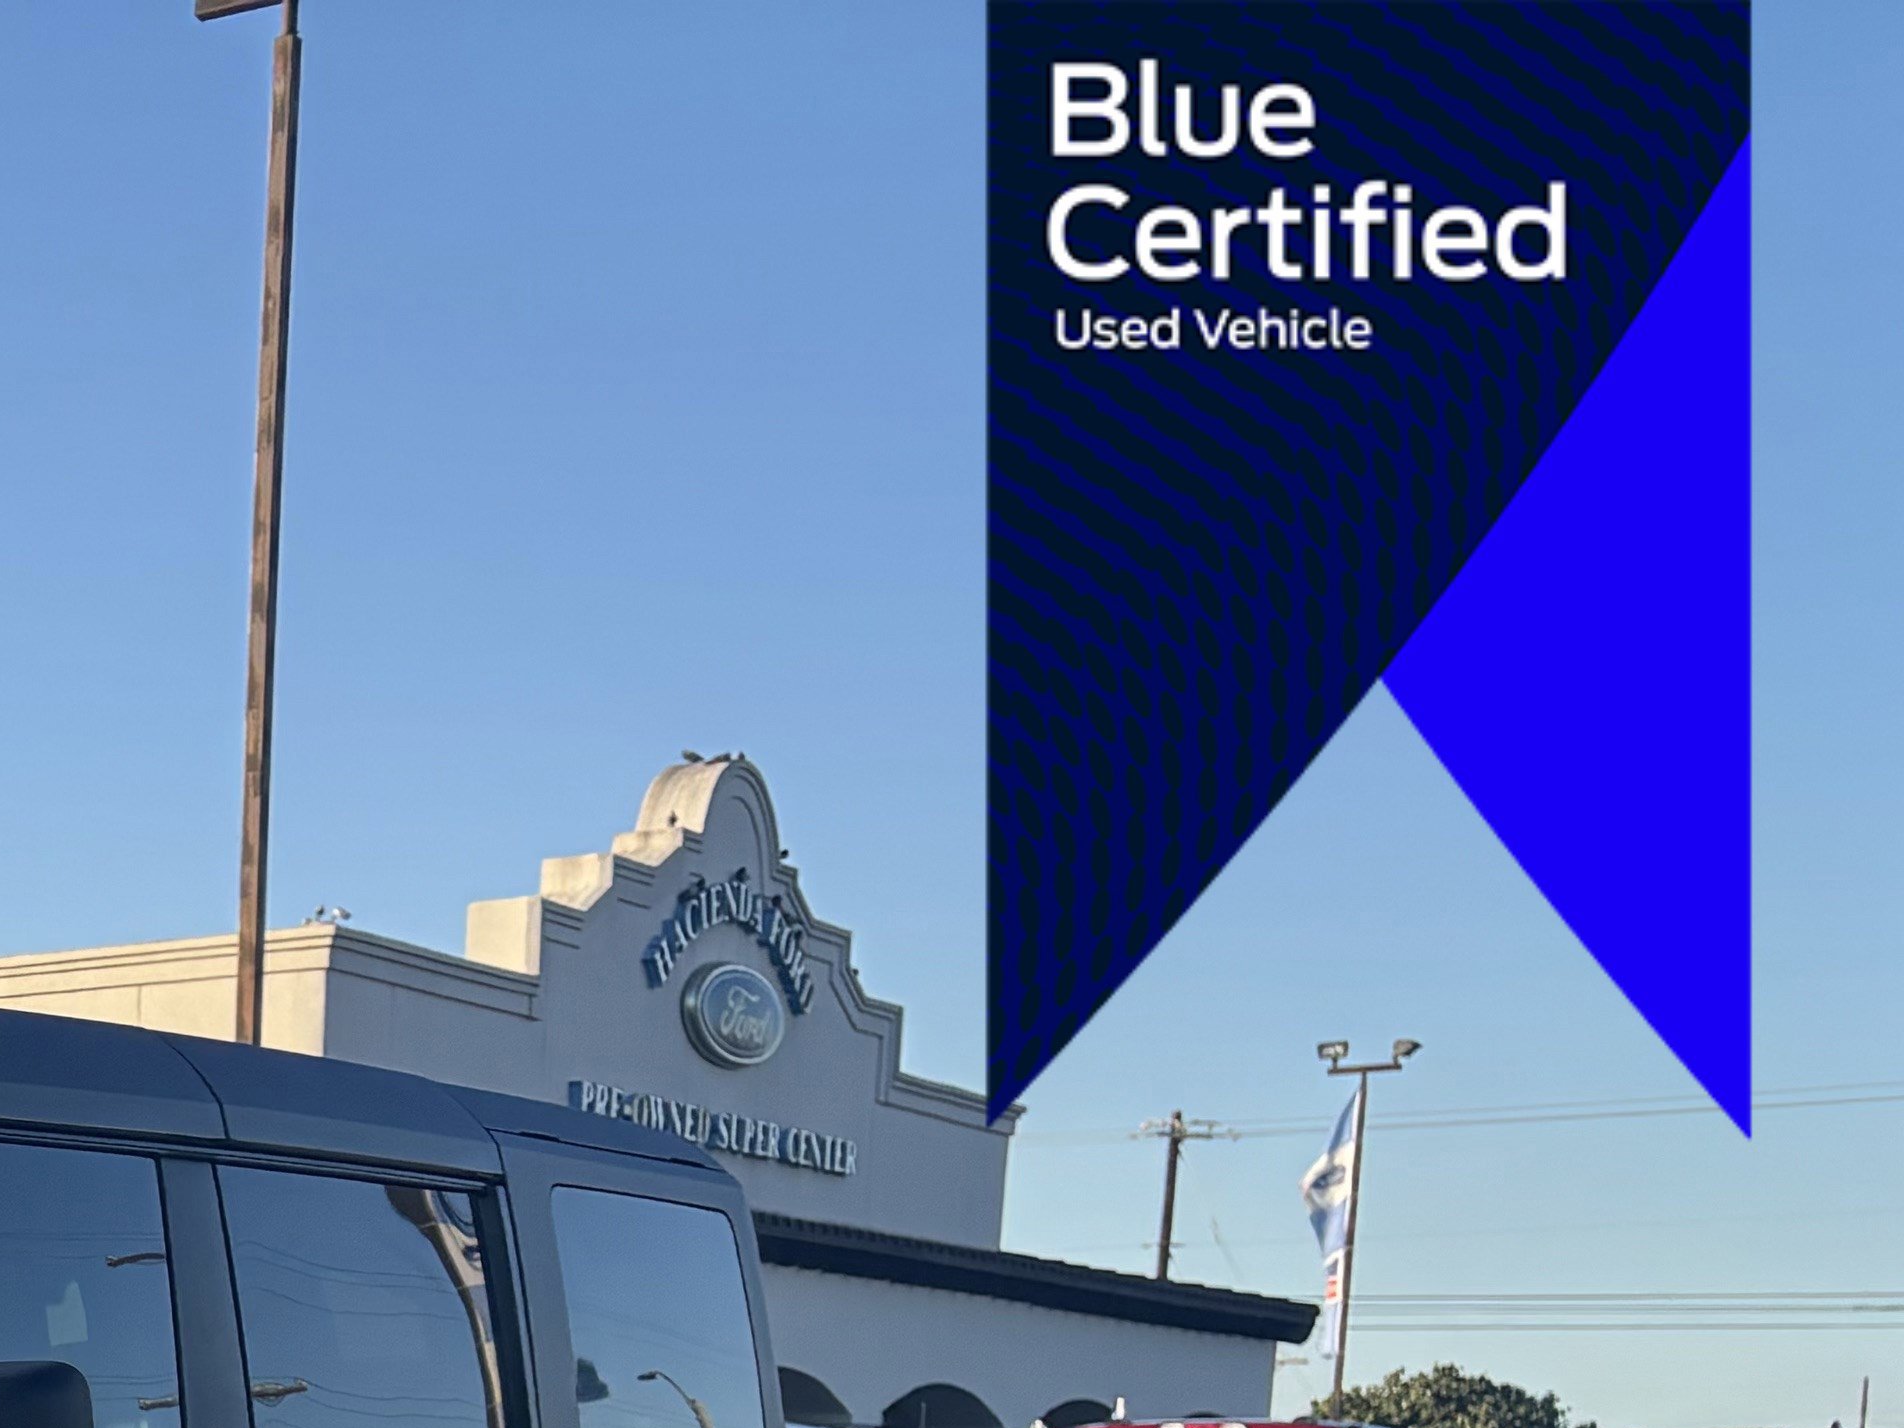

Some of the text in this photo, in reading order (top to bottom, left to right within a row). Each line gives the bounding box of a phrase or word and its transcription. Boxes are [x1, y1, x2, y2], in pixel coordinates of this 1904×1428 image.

[653, 880, 764, 983] HACIENDA
[720, 985, 770, 1045] Ford
[581, 1081, 858, 1175] PRE-OWNED SUPER CENTER
